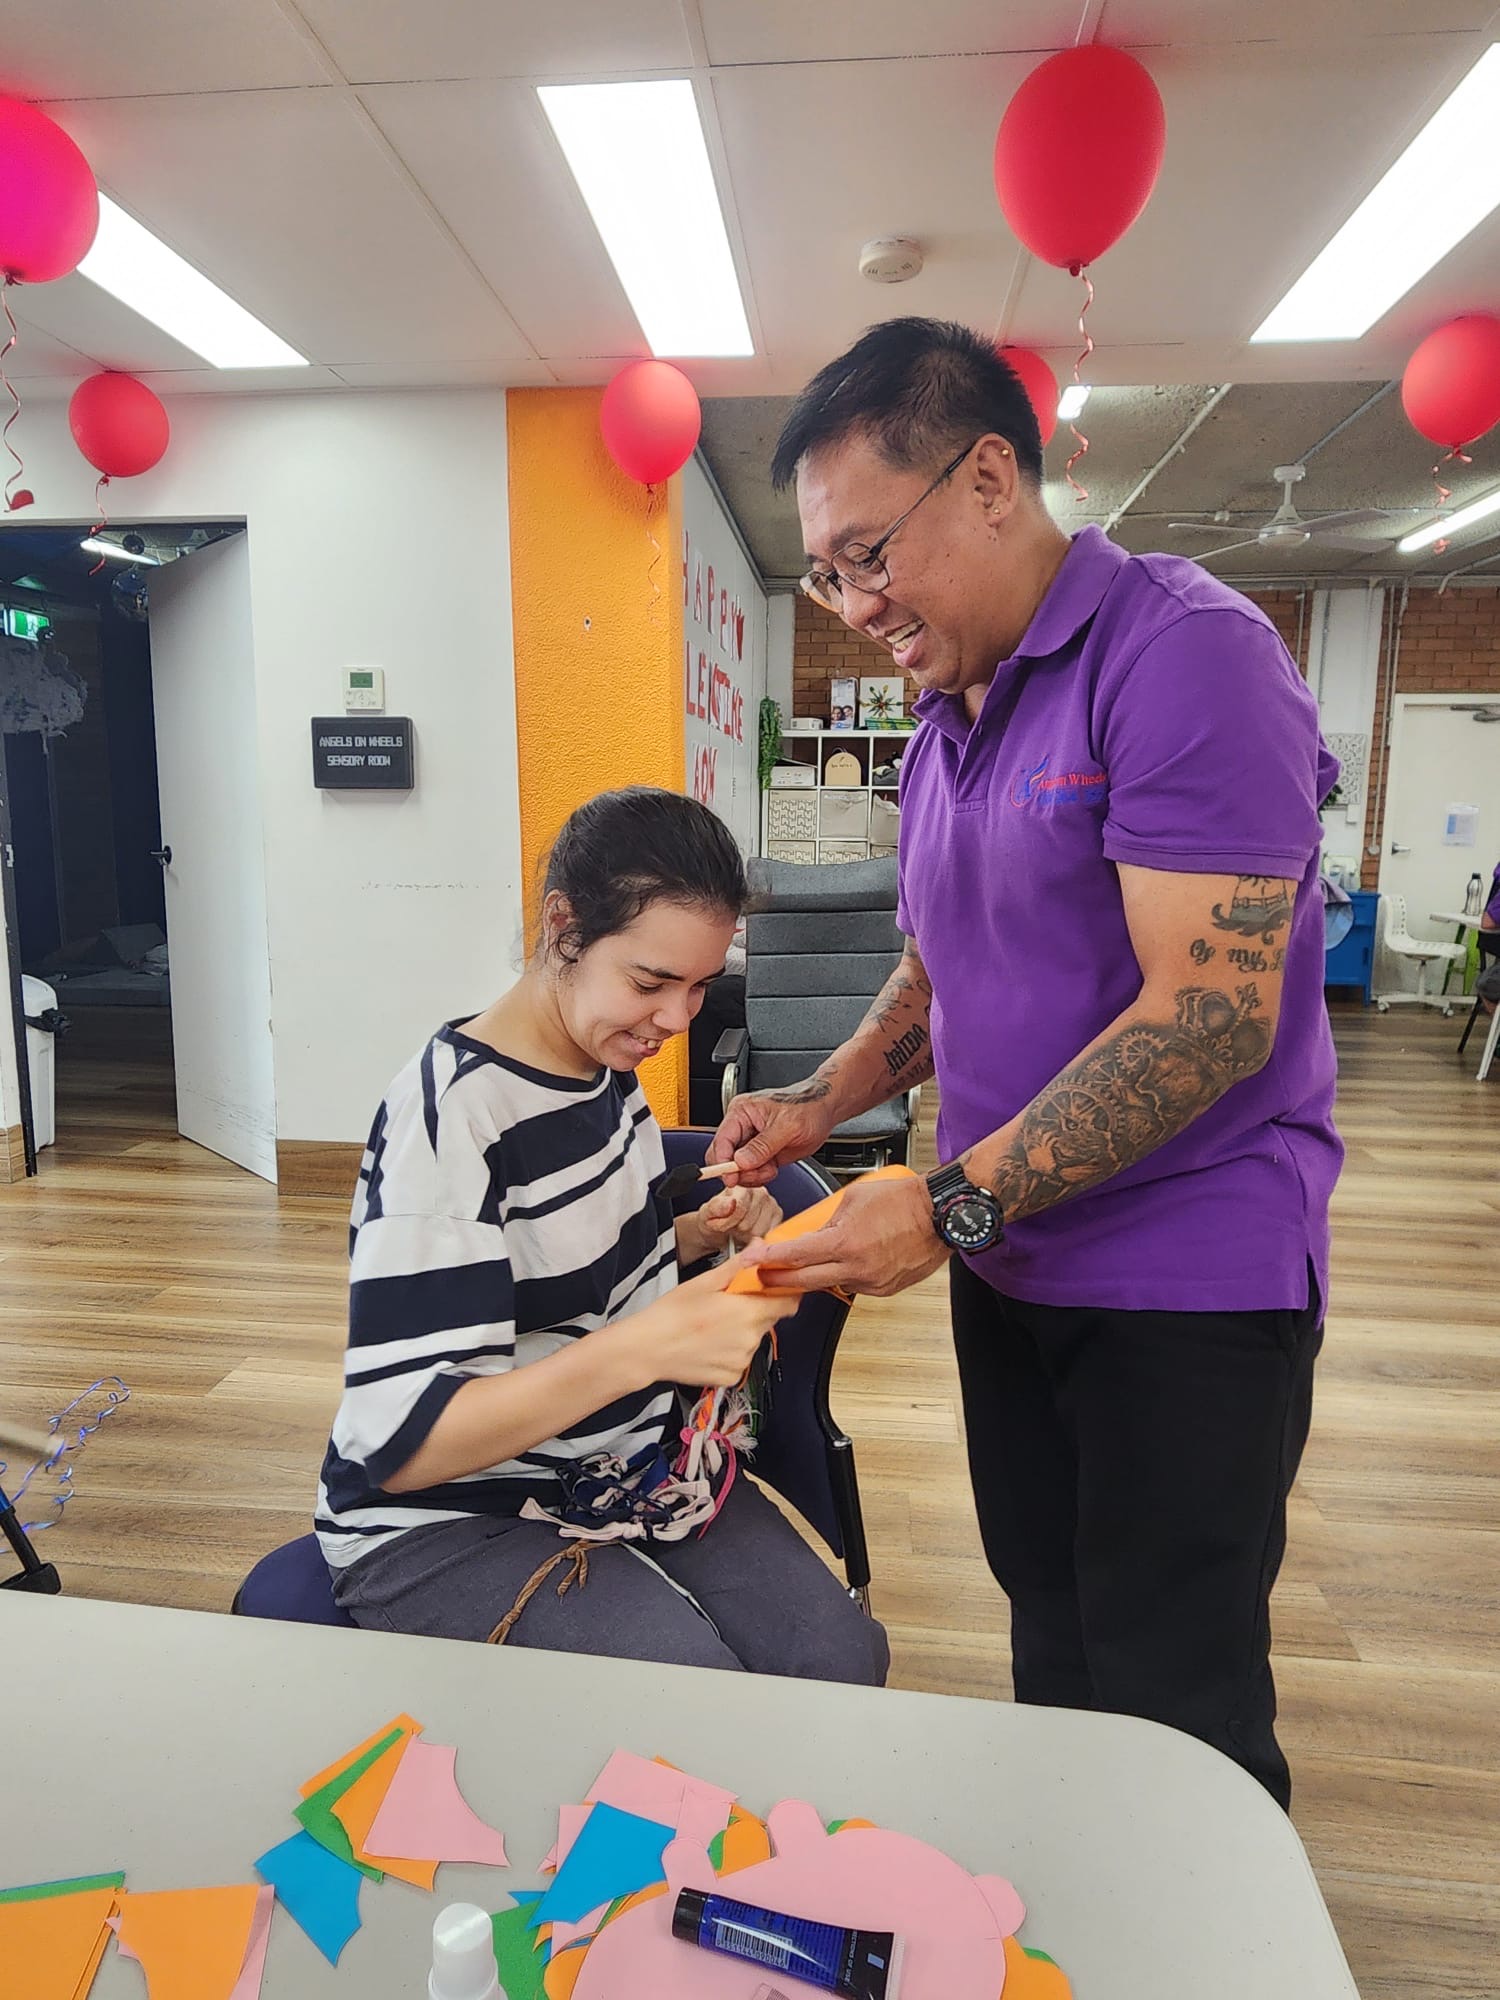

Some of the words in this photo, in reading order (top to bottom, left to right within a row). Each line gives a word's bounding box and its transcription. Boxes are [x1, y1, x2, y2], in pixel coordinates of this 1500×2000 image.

[319, 735, 353, 747] ANGELS
[354, 735, 367, 747] ON
[368, 735, 403, 747] WHEELS
[326, 755, 366, 767] SENSORY
[367, 755, 391, 767] ROOM
